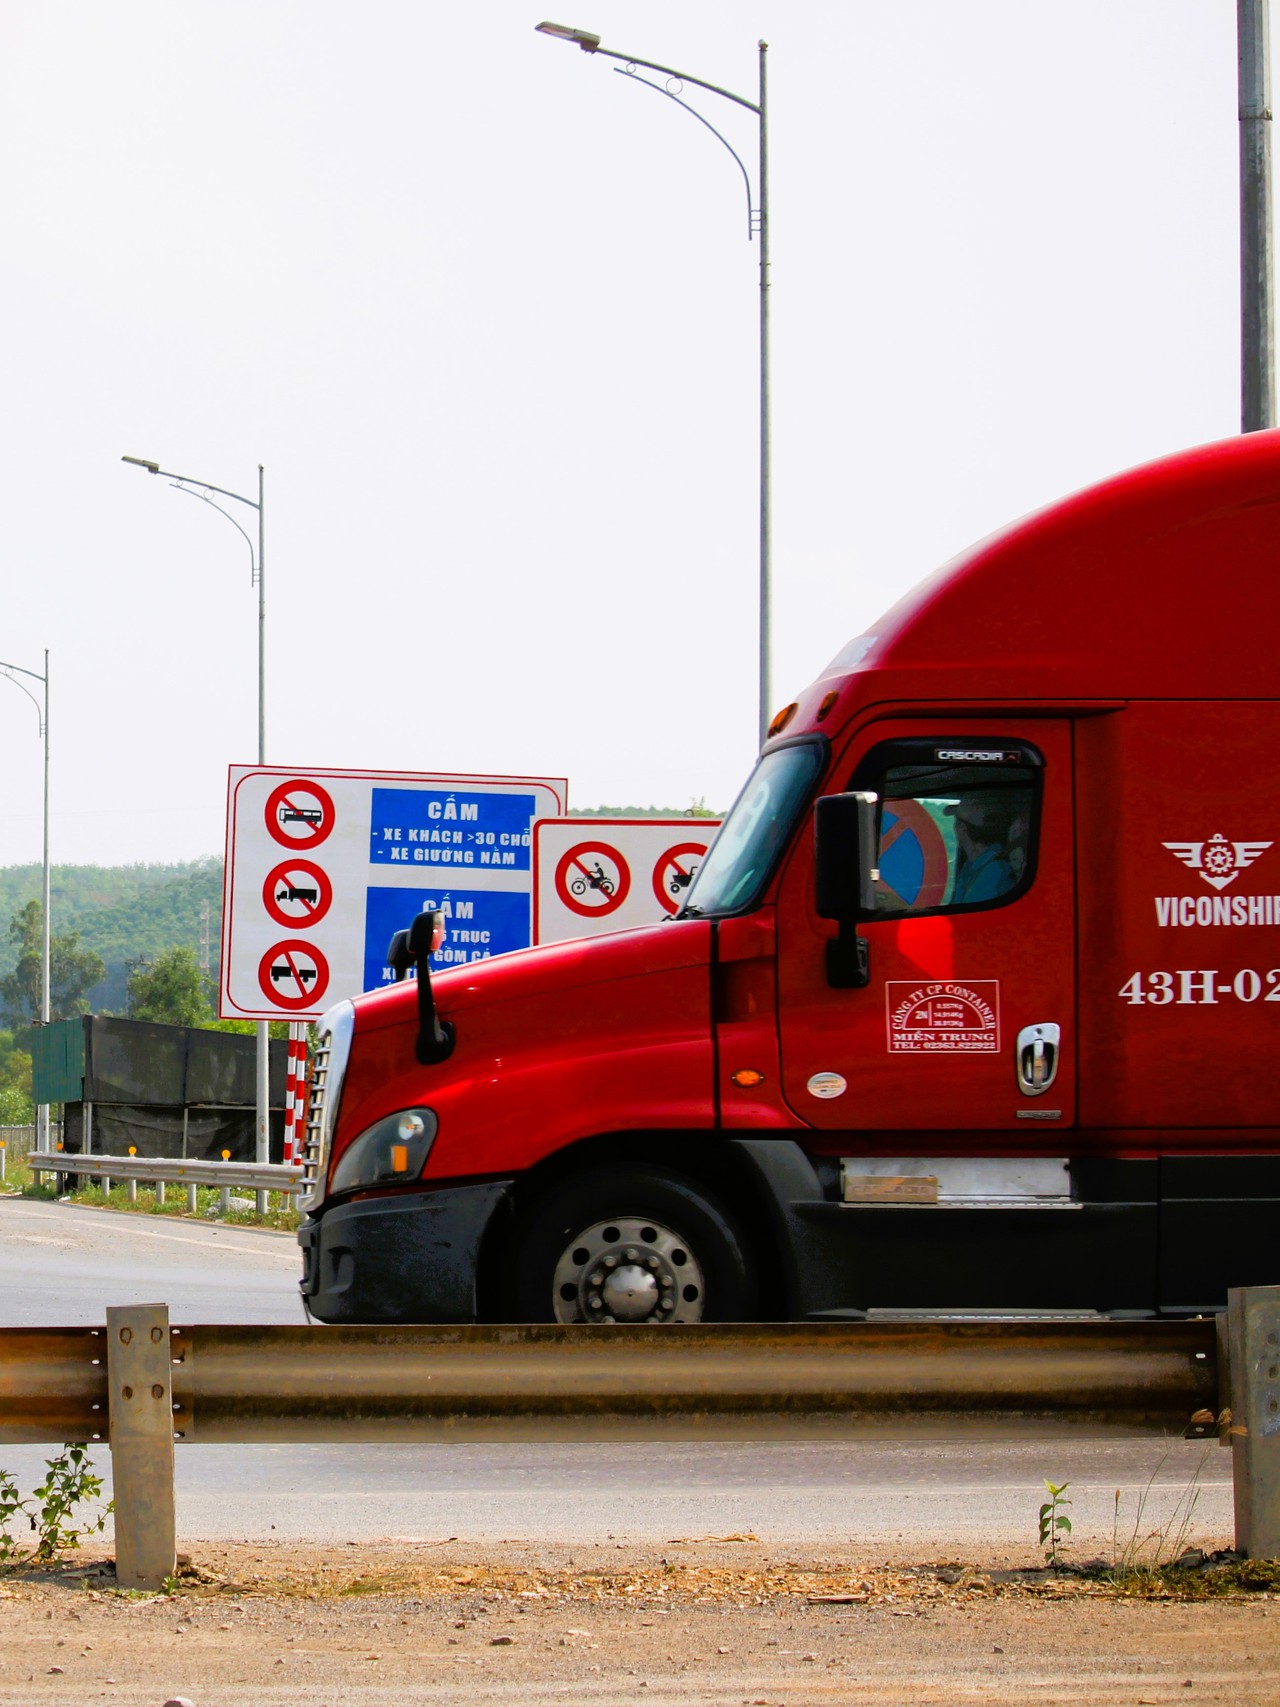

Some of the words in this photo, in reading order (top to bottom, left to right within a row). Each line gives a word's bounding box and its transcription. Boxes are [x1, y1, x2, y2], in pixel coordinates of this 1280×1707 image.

[938, 751, 1003, 761] CASCADIA
[427, 794, 479, 821] CẤM
[383, 828, 402, 841] XE
[408, 825, 463, 844] KHÁCH
[500, 828, 531, 847] CHỖ
[390, 847, 409, 860] XE
[413, 847, 474, 864] GIƯỜNG
[480, 847, 516, 865] NẰM
[451, 929, 491, 946] TRỤC
[433, 945, 467, 963] GỒM
[908, 988, 924, 1002] TY
[926, 984, 943, 995] CP
[945, 984, 996, 1030] CONTAINER
[939, 1033, 995, 1041] TRUNG
